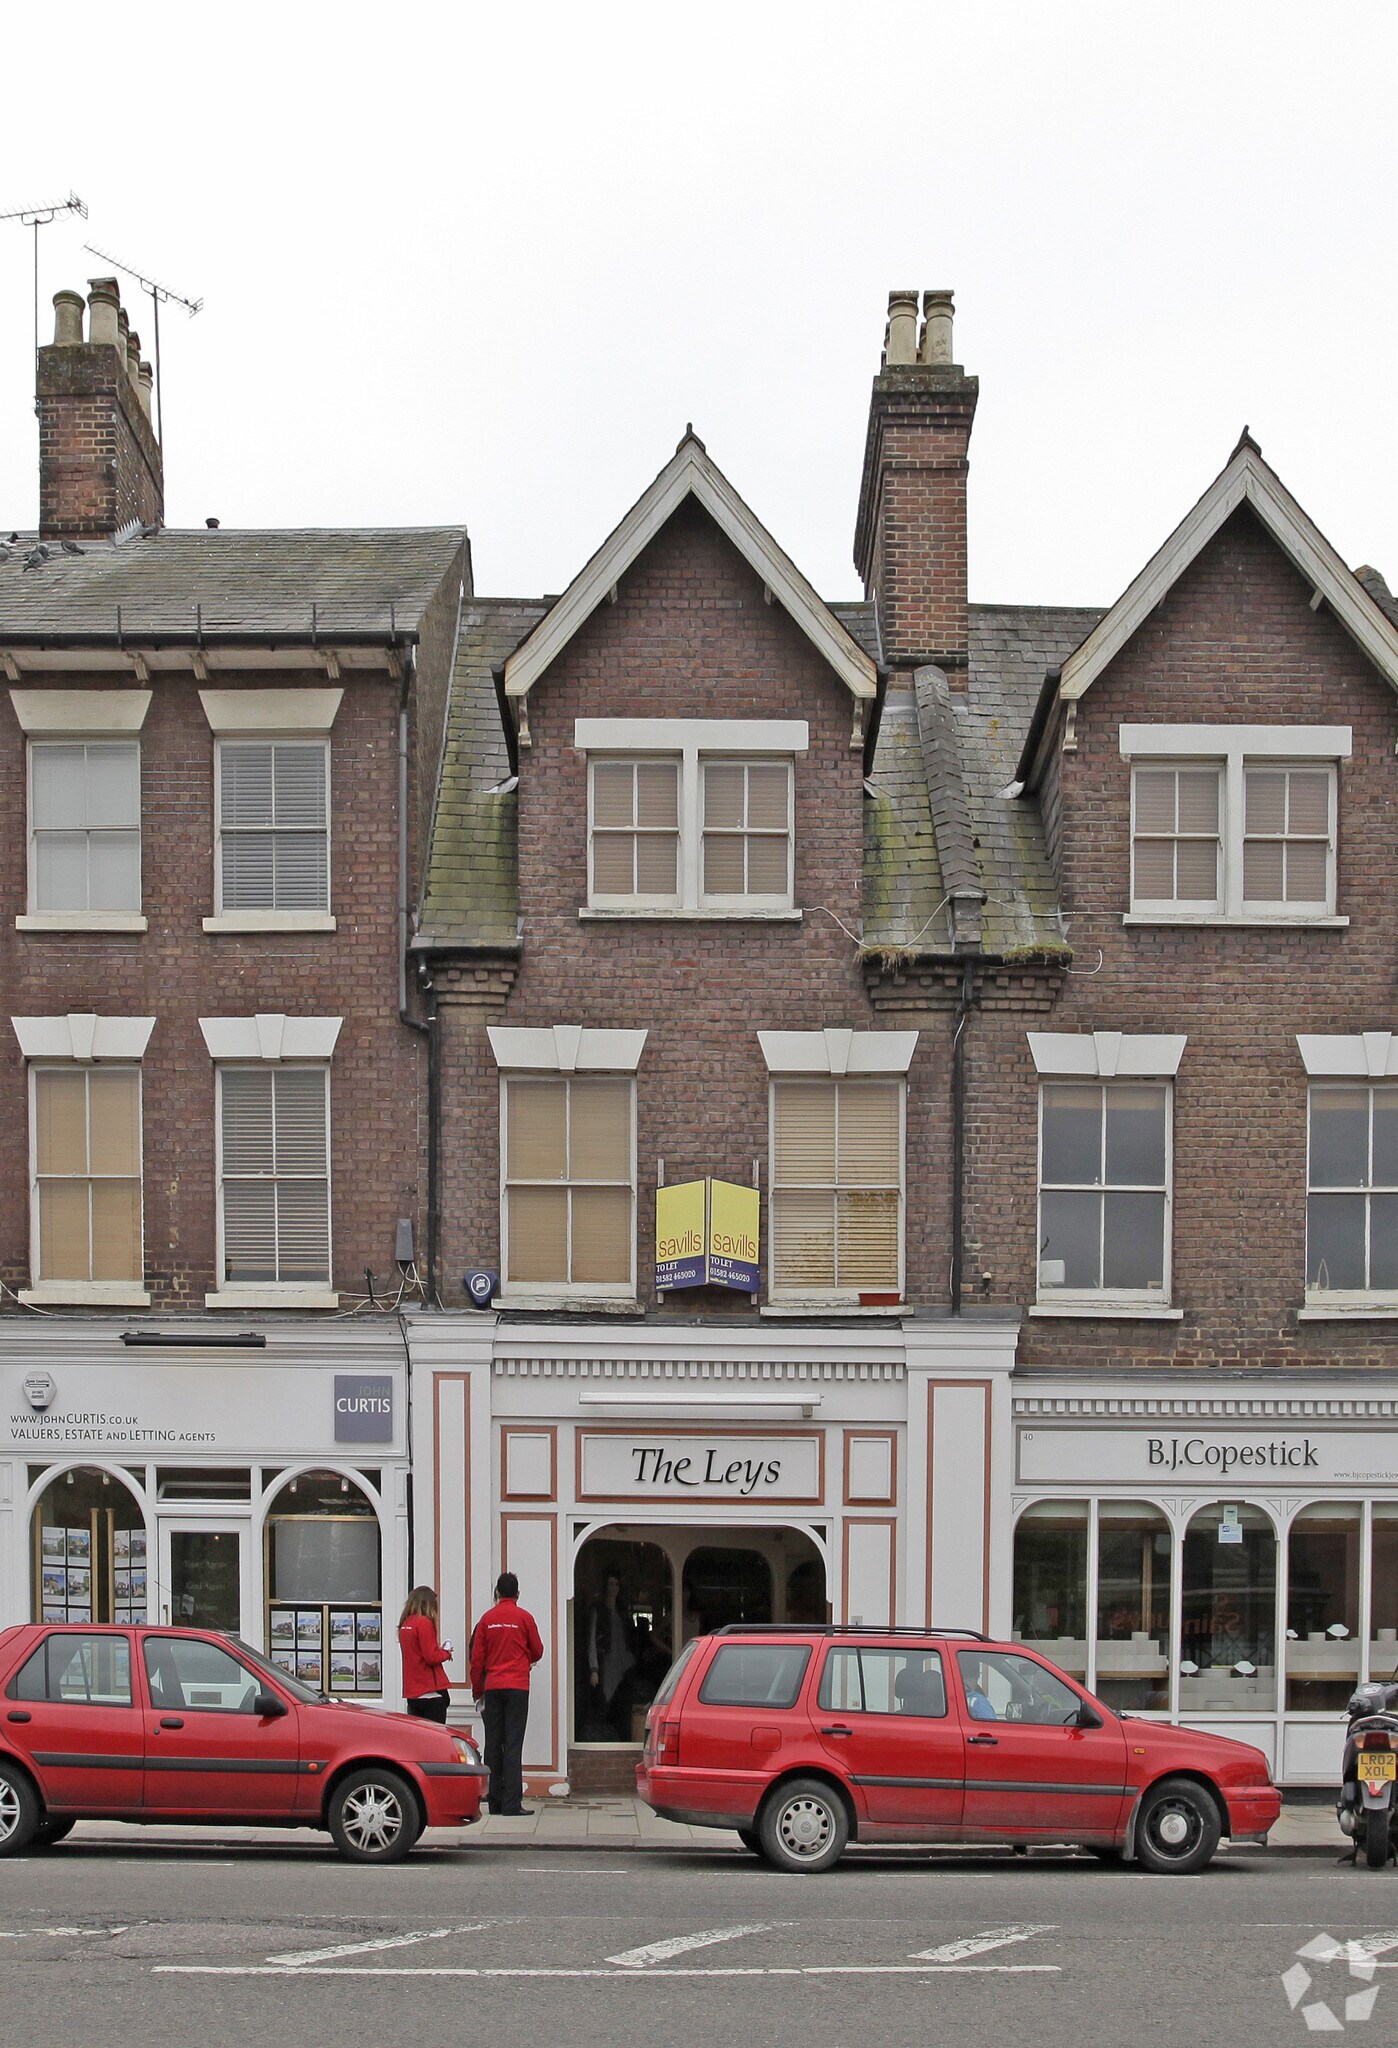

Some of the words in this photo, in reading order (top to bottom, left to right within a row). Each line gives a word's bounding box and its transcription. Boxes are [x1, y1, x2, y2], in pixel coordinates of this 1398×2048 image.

[658, 1229, 702, 1258] savills
[713, 1233, 756, 1259] savills
[656, 1264, 666, 1273] TO
[666, 1261, 679, 1271] LET
[710, 1256, 720, 1265] TO
[720, 1258, 733, 1268] LET
[709, 1267, 728, 1278] 01582
[359, 1386, 390, 1396] JOHN
[336, 1398, 391, 1413] CURTIS
[10, 1428, 63, 1441] VALUERS,
[65, 1429, 103, 1440] ESTATE
[106, 1432, 127, 1440] AND
[129, 1430, 176, 1441] LETTING
[179, 1432, 216, 1442] AGENTS
[631, 1448, 700, 1486] The
[703, 1449, 781, 1495] Leys
[1360, 1754, 1394, 1766] LR02
[1364, 1766, 1389, 1777] XOL
